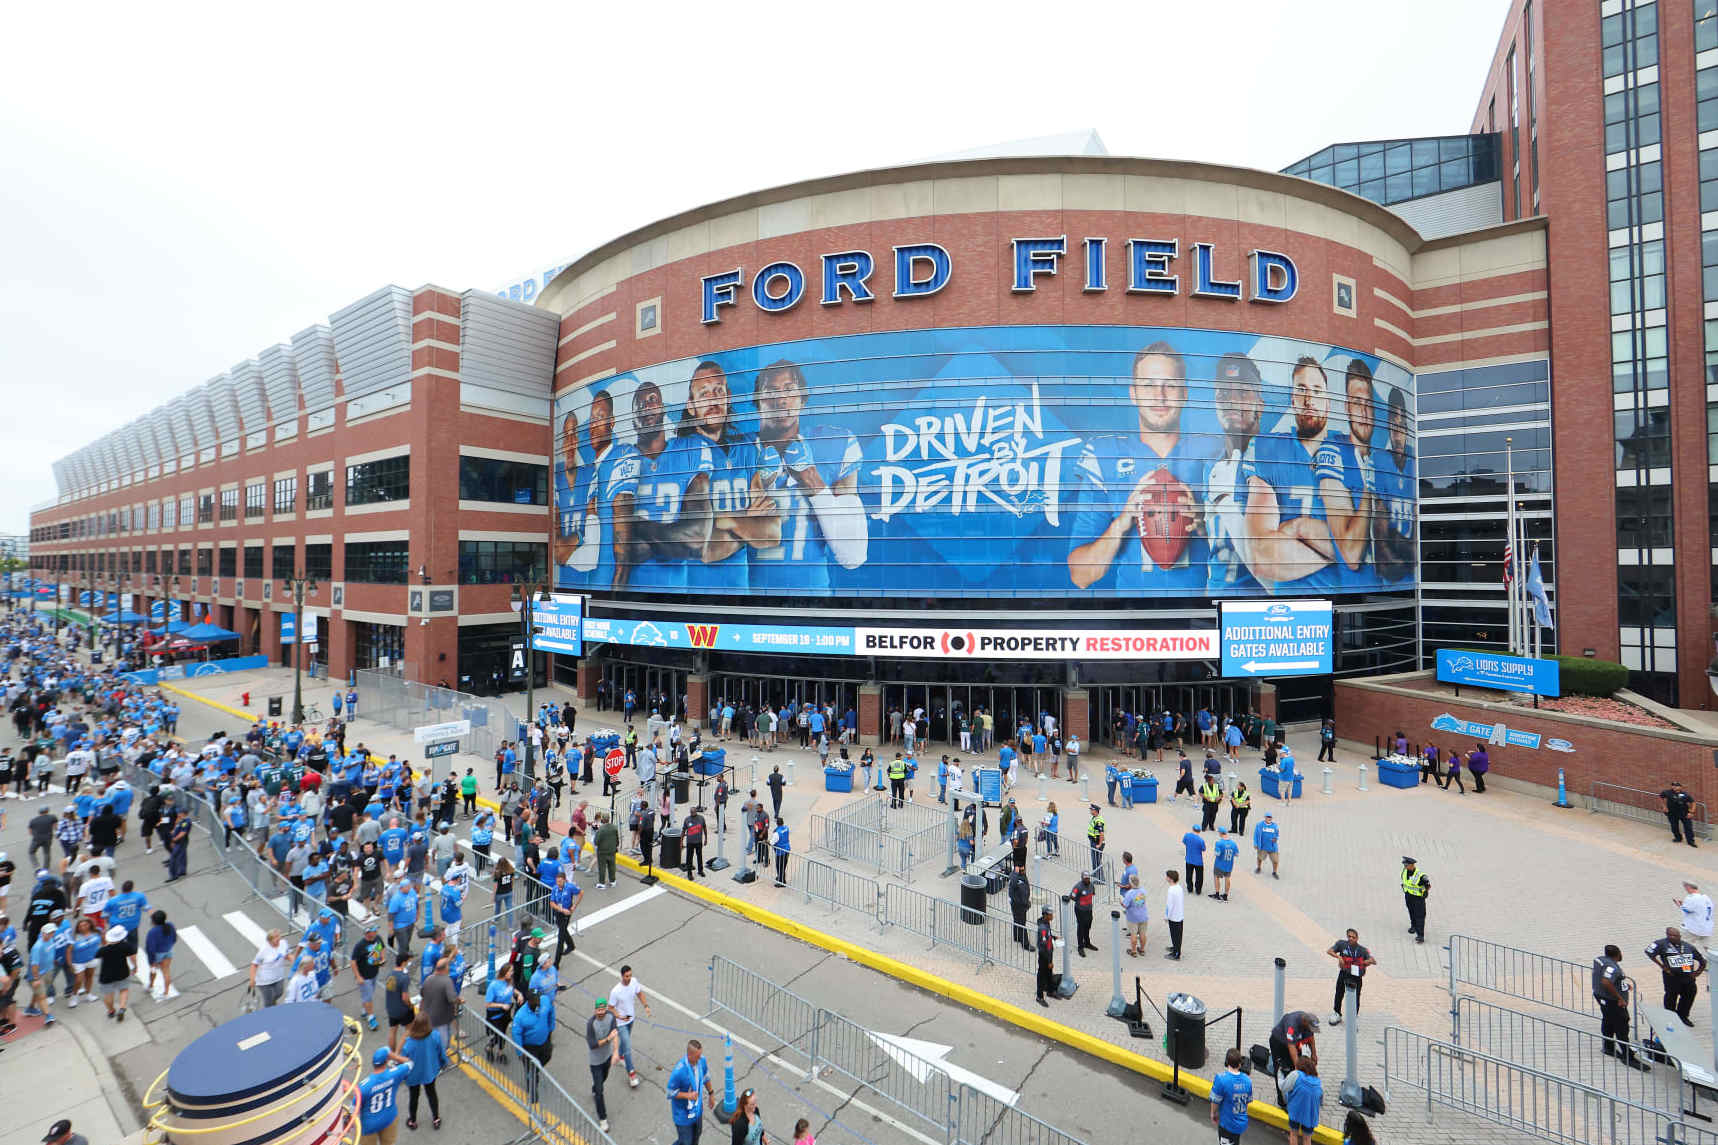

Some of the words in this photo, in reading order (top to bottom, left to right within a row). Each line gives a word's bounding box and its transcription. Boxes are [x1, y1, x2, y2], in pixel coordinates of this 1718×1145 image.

[701, 242, 953, 325] FORD
[1010, 234, 1300, 305] FIELD
[880, 382, 1044, 462] DRIVEN
[992, 433, 1028, 466] BY
[870, 437, 1083, 527] DETROIT
[560, 615, 580, 627] ENTRY
[545, 627, 577, 641] AVAILABLE
[685, 623, 721, 649] W
[752, 633, 798, 645] SEPTEMBER
[835, 635, 850, 647] PM
[1224, 625, 1294, 641] ADDITIONAL
[1296, 624, 1330, 639] ENTRY
[865, 634, 935, 650] BELFOR
[980, 636, 1080, 652] PROPERTY
[1086, 636, 1210, 652] RESTORATION
[1230, 643, 1266, 658] GATES
[1269, 641, 1325, 656] AVAILABLE
[512, 650, 525, 668] A
[1475, 659, 1499, 673] LIONS
[1501, 661, 1534, 676] SUPPLY
[1469, 725, 1490, 737] GATE
[1488, 723, 1507, 747] A
[606, 756, 624, 769] STOP
[370, 1087, 393, 1114] 81
